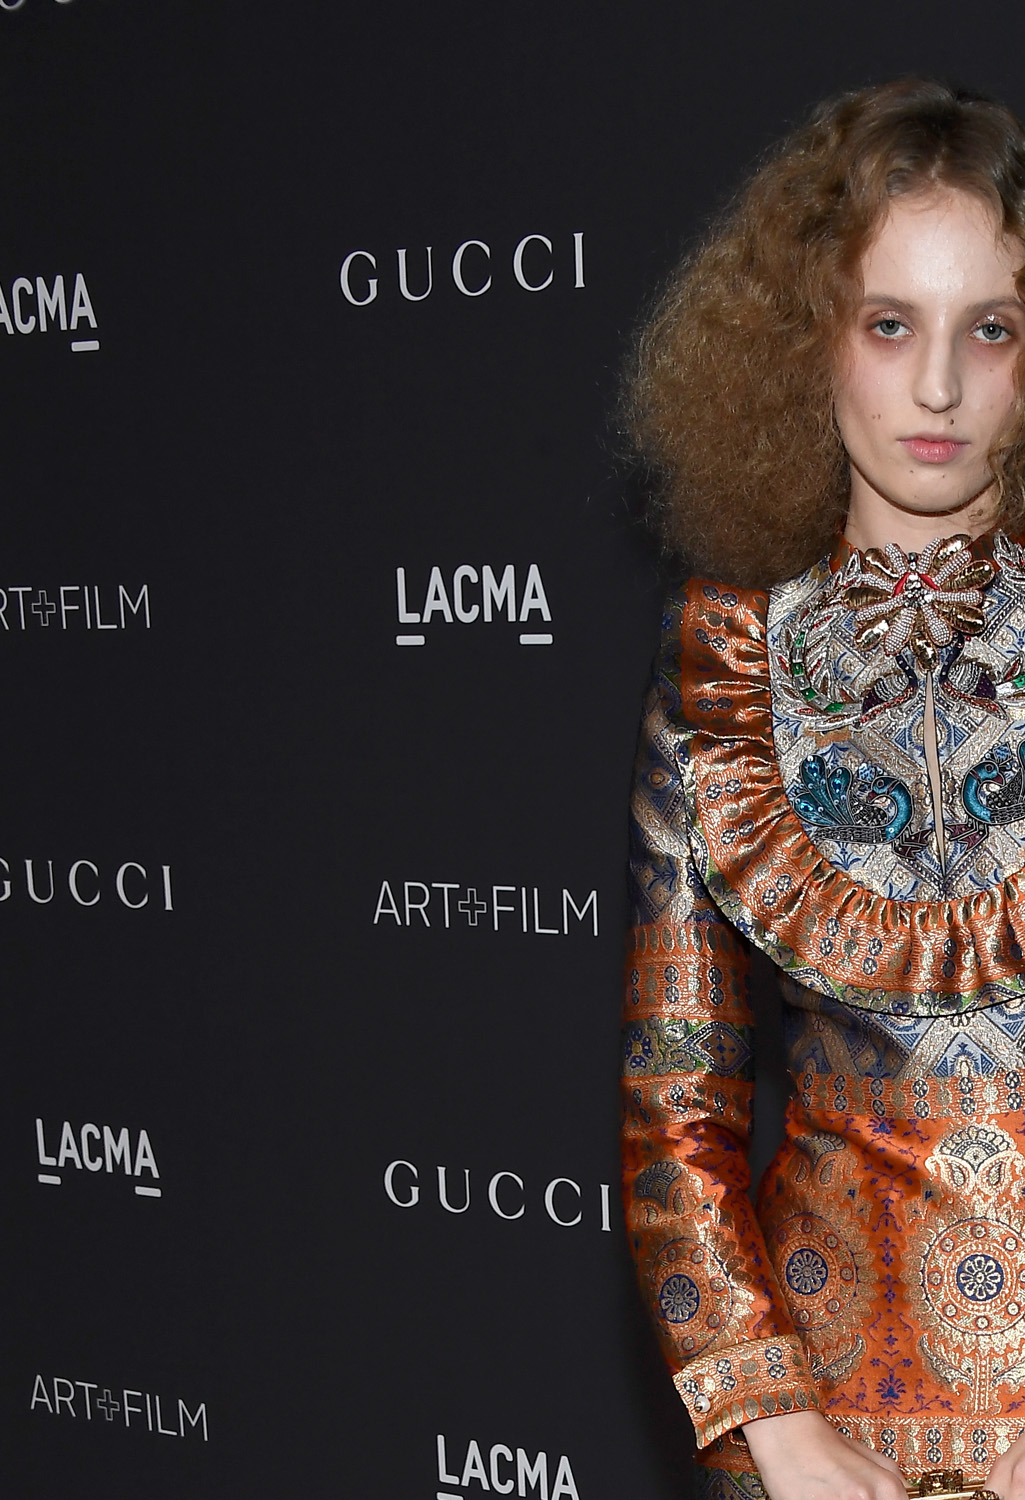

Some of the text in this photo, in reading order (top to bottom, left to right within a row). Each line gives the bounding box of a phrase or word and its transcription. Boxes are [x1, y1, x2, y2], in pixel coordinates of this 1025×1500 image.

[340, 232, 586, 306] GUCCI
[396, 563, 552, 624] LACMA
[373, 880, 599, 937] ART+FILM
[35, 1118, 160, 1179] LACMA
[384, 1160, 612, 1232] GUCCI
[30, 1374, 208, 1442] ART+FILM
